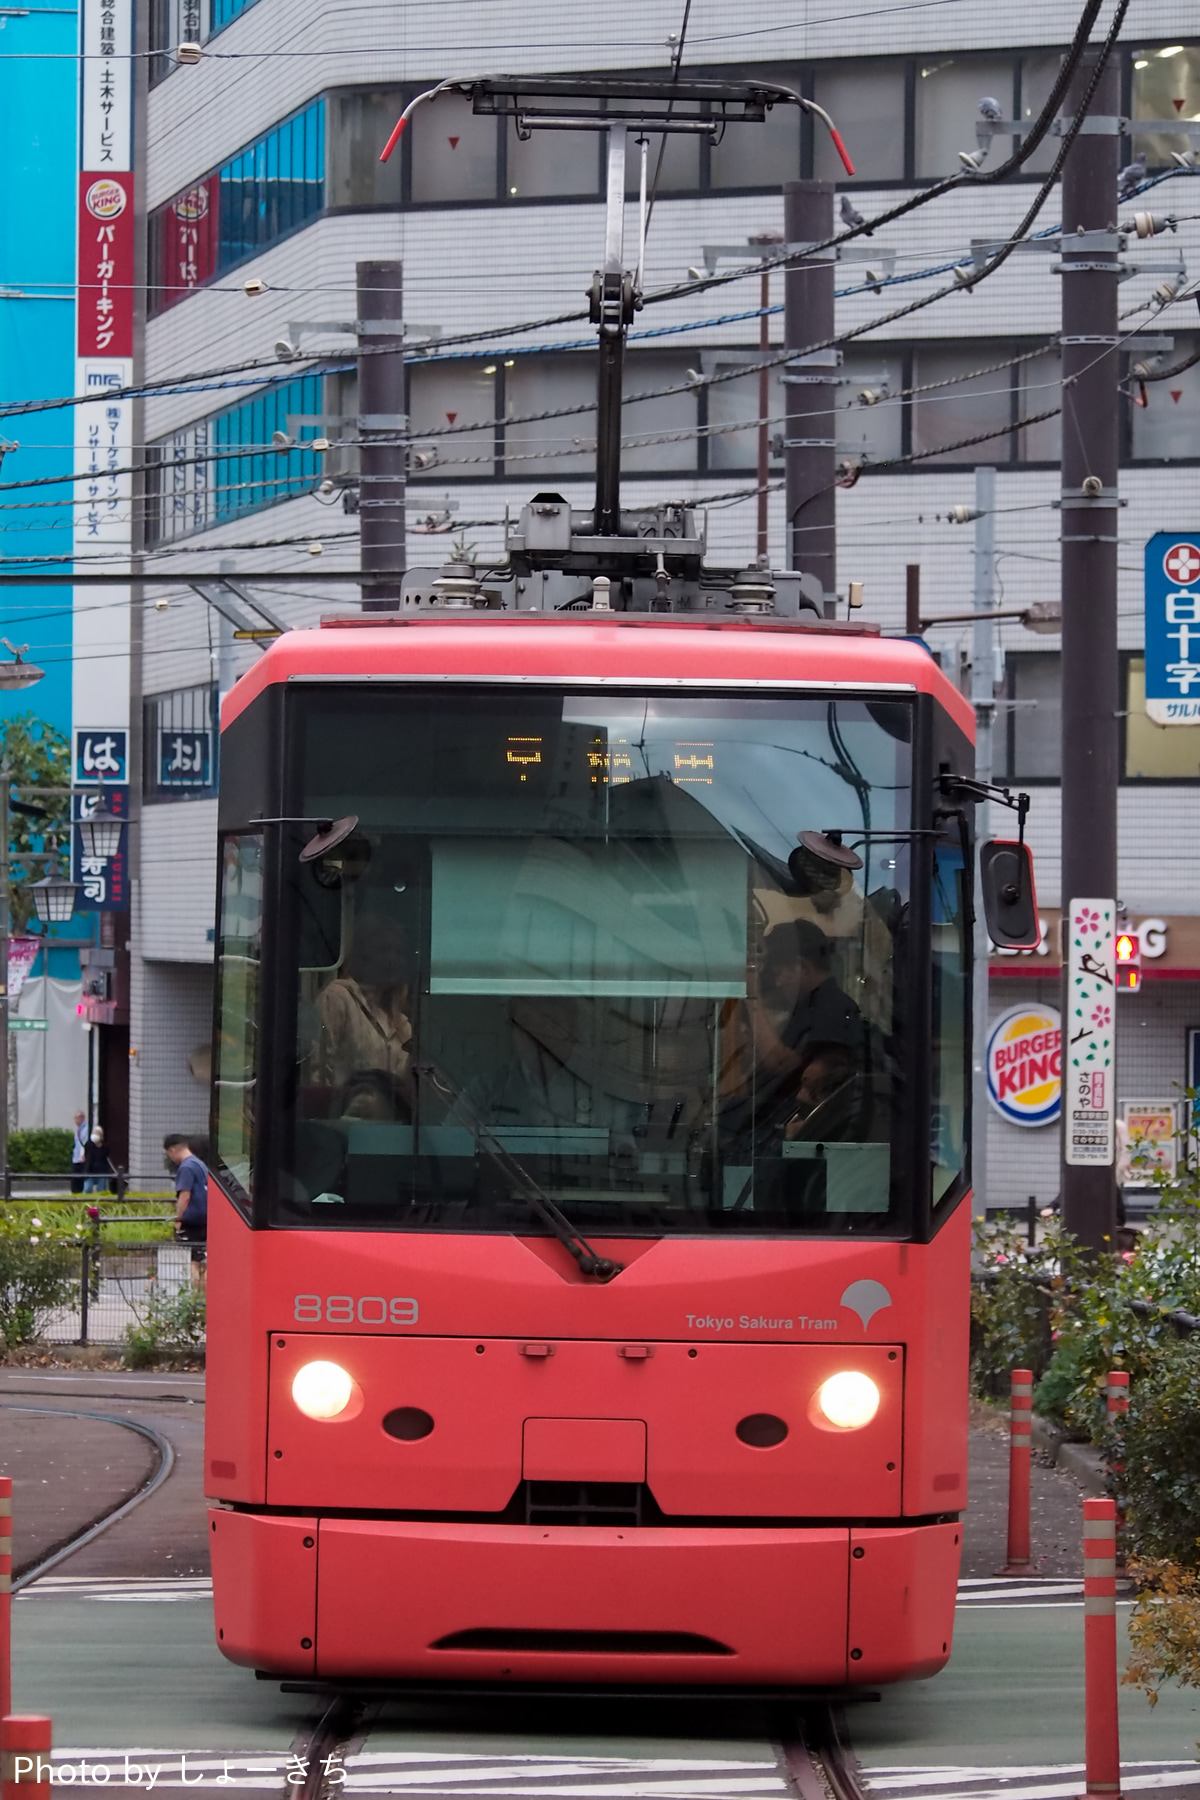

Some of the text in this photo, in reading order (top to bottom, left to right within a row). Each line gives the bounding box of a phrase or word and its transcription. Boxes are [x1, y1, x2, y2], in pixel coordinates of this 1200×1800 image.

[91, 188, 119, 201] BURGER
[92, 194, 121, 210] KING
[96, 225, 115, 350] バーガーキング
[1165, 588, 1200, 695] 白十字
[83, 736, 120, 772] は
[80, 794, 107, 903] は寿司
[1079, 1072, 1091, 1109] さのや
[294, 1294, 419, 1325] 8809
[686, 1314, 838, 1332] Tokyo Sakura Tram
